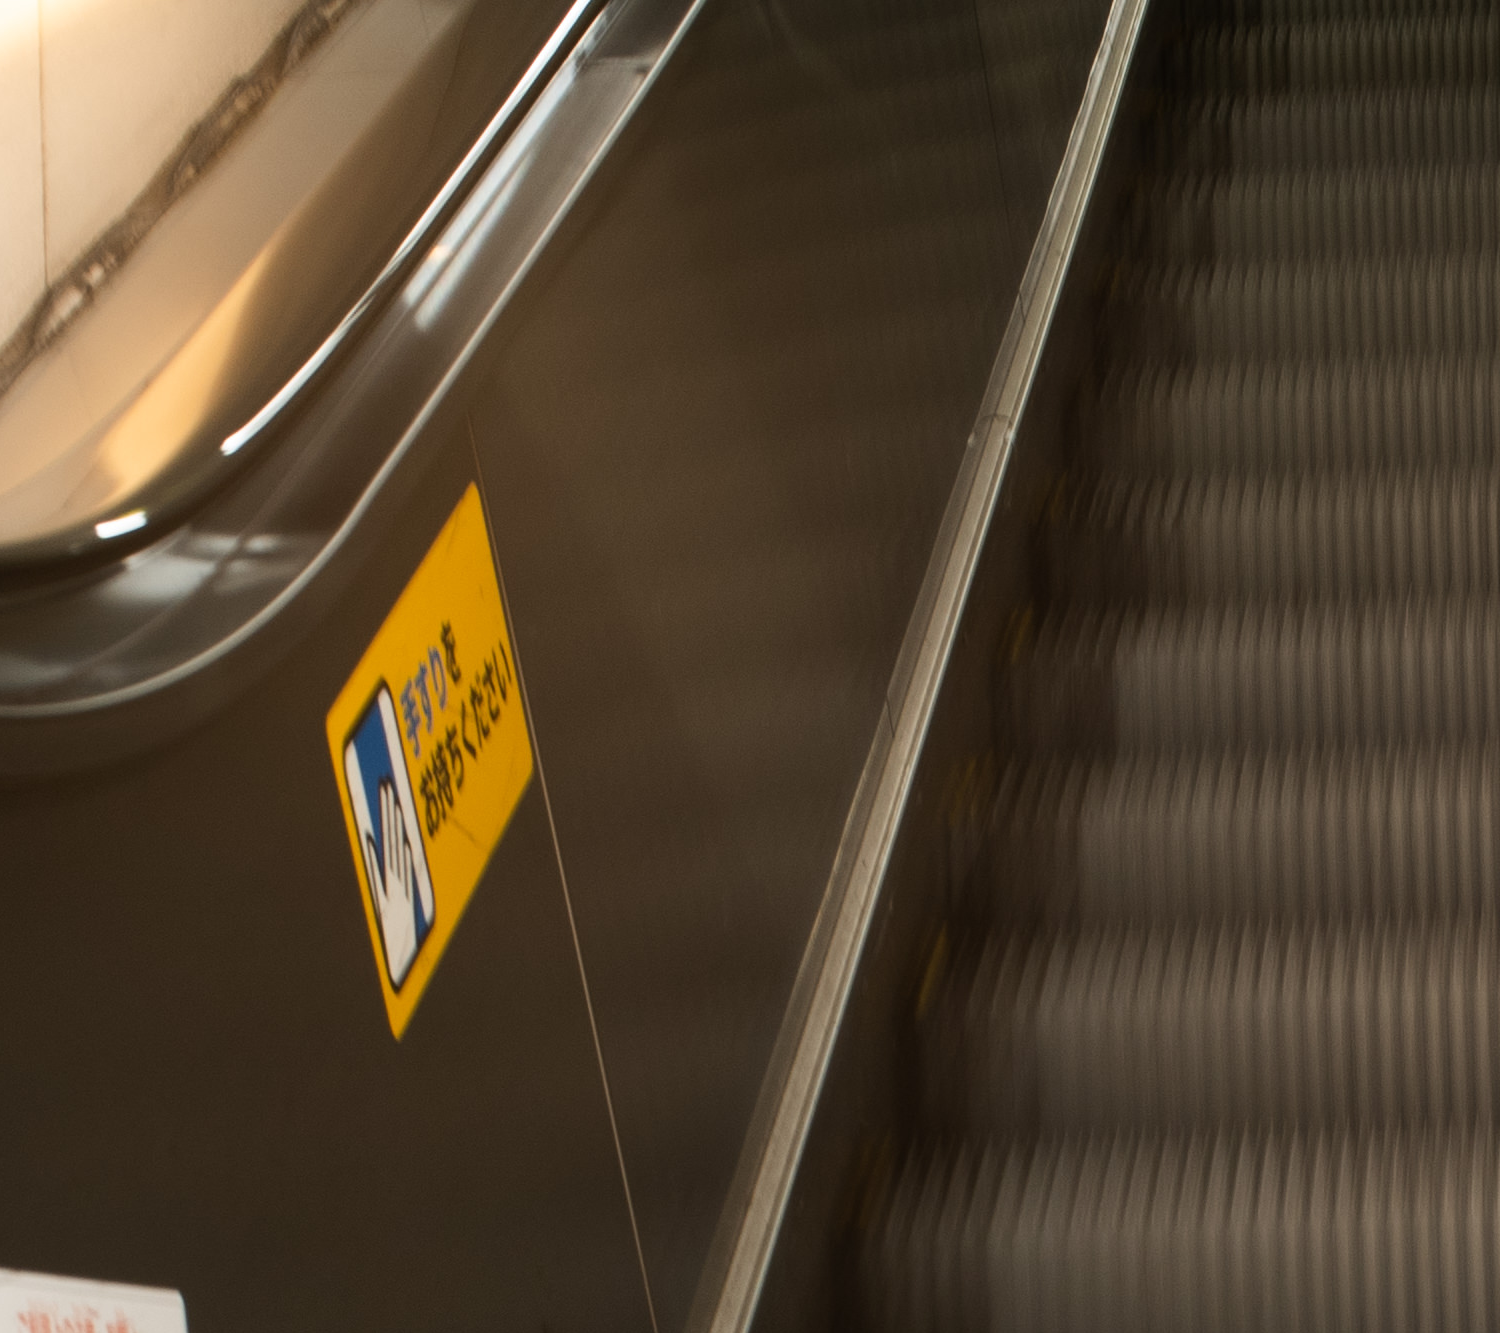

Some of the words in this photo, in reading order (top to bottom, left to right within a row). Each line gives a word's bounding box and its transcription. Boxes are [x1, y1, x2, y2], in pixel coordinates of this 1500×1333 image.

[400, 619, 461, 759] 手すりを
[419, 638, 512, 837] お持ちください
